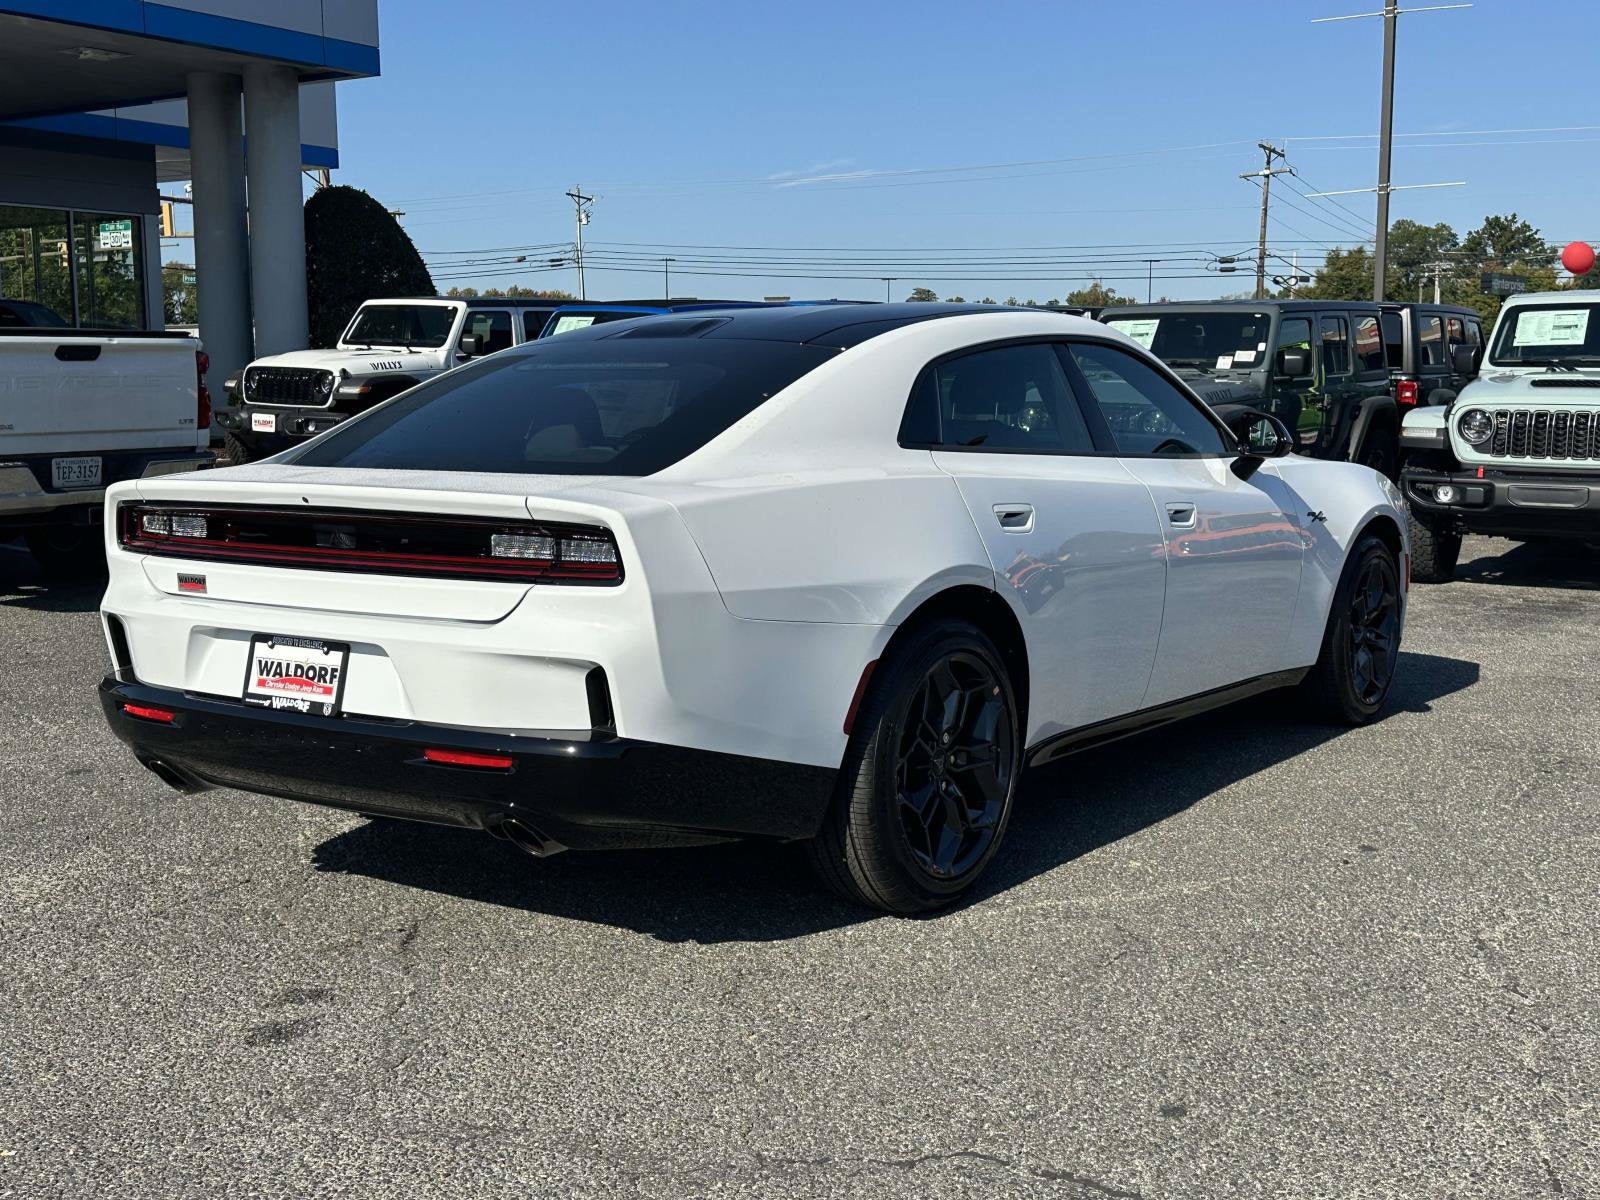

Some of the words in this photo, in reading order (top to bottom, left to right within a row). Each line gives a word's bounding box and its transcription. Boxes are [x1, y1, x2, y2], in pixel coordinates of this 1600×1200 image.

[370, 361, 403, 370] WILLYS
[56, 464, 99, 480] TEP-3157
[178, 576, 206, 585] WALDORF
[258, 659, 338, 684] WALDORF
[272, 697, 310, 712] WALDORF
